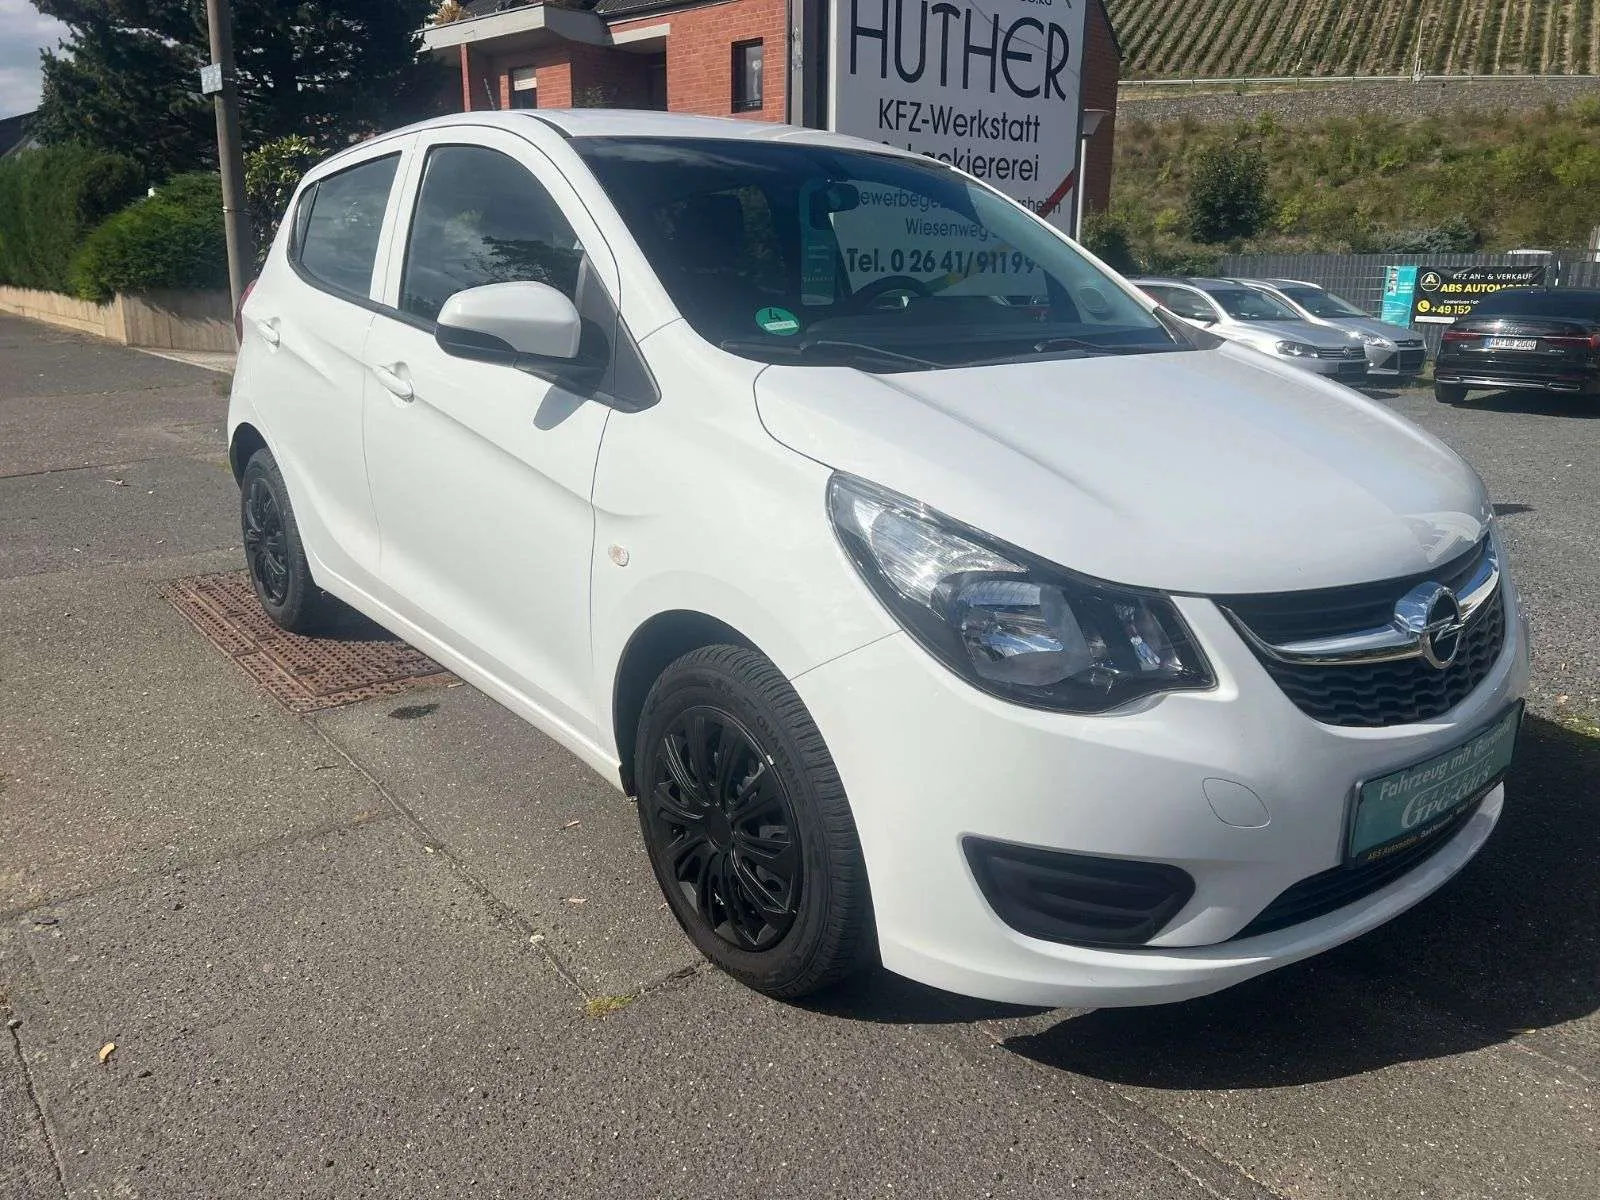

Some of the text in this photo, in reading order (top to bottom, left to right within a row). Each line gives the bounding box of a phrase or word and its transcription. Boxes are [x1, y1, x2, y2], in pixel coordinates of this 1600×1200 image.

[878, 98, 1040, 143] KFZ-Werkstatt
[905, 217, 988, 241] Wiesenweg
[846, 248, 885, 273] Tel.
[1440, 284, 1463, 293] ABS
[1431, 305, 1451, 314] +49
[1380, 762, 1447, 801] Fahrzeug
[1451, 746, 1471, 770] mit
